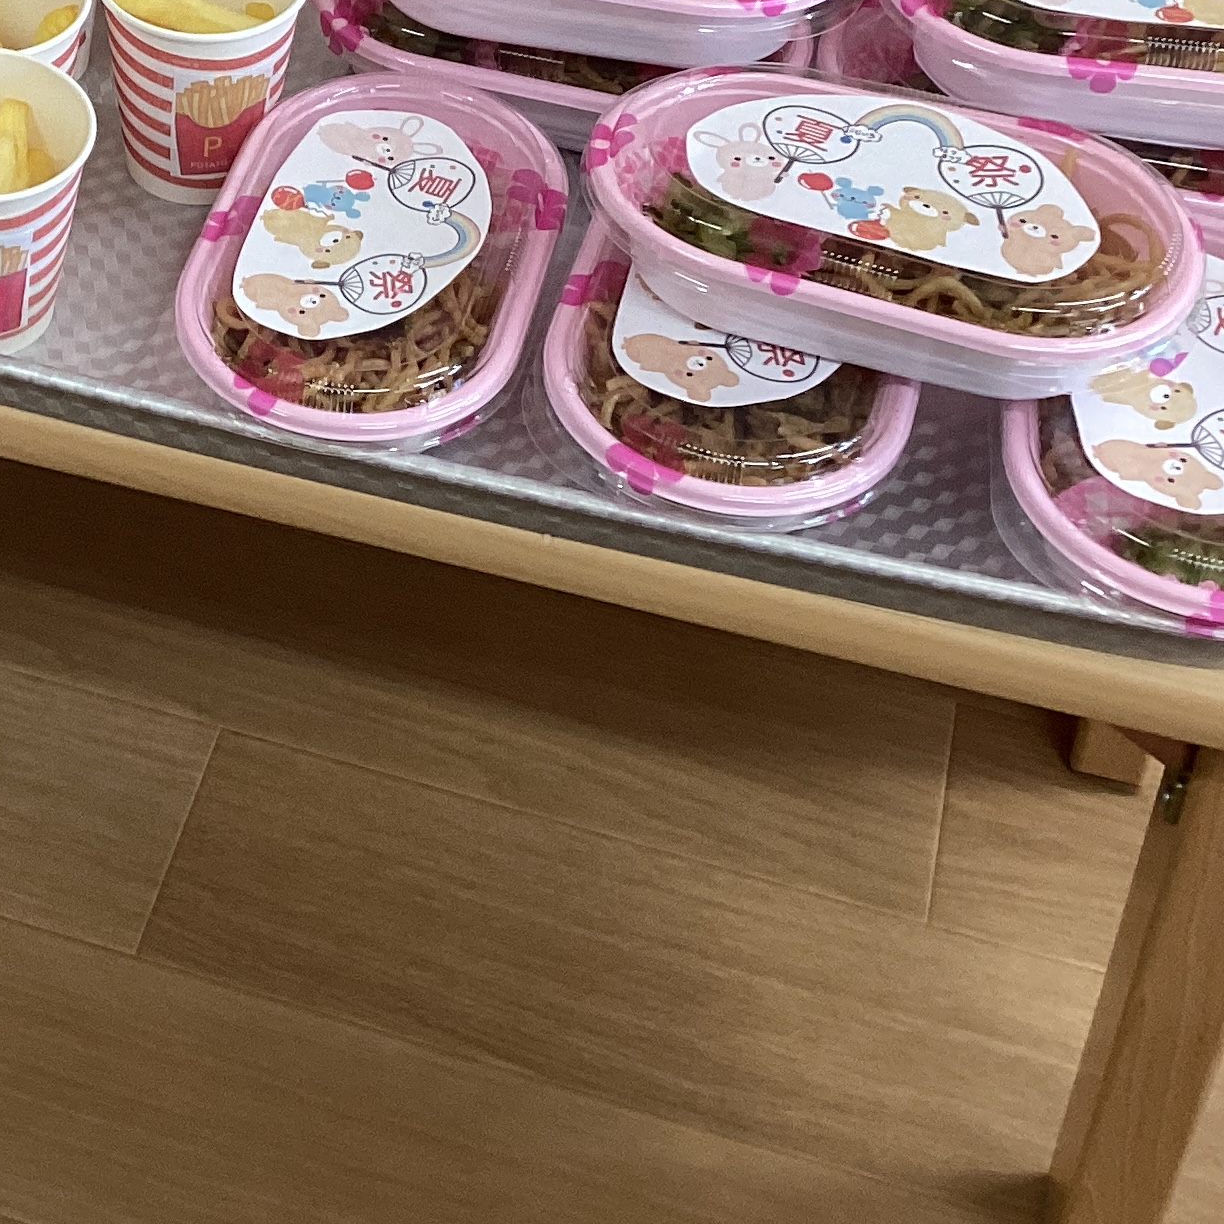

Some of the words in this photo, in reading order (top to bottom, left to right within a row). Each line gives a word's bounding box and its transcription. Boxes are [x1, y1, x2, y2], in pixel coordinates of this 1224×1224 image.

[203, 136, 223, 158] P
[783, 114, 842, 152] 夏
[407, 167, 463, 204] 夏
[966, 155, 1020, 187] 祭
[369, 269, 414, 301] 祭
